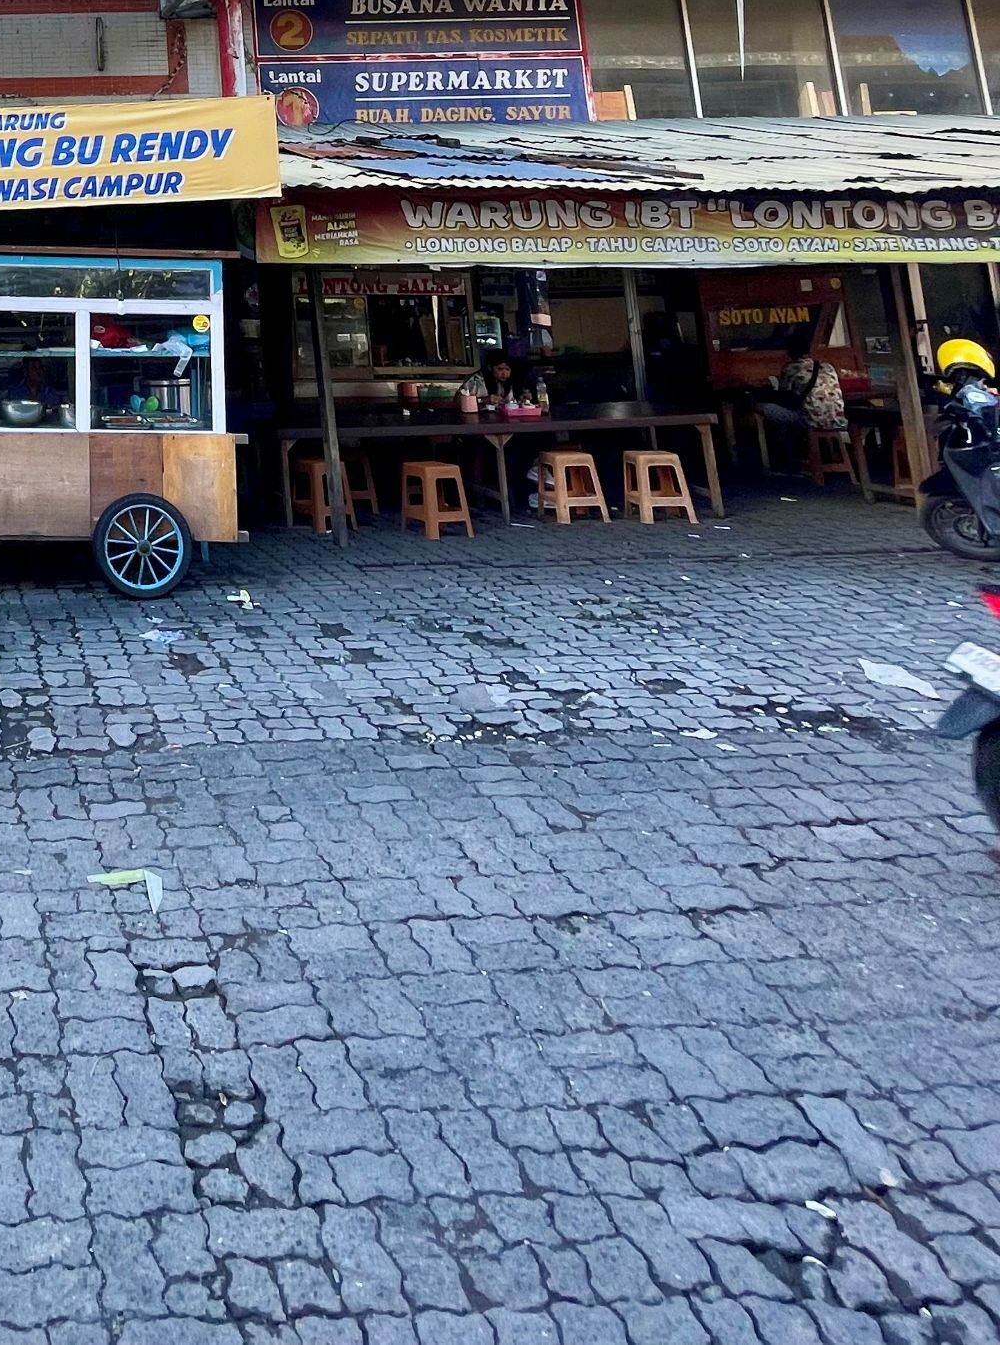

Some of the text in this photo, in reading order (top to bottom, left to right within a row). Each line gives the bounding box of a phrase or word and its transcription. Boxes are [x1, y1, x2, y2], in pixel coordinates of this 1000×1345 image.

[277, 13, 305, 46] 2
[469, 27, 569, 43] KOSMETIK
[269, 69, 322, 83] Lantai
[354, 68, 569, 92] SUPERMARKET
[505, 105, 571, 121] SAYUR
[52, 134, 105, 167] BU
[110, 128, 234, 164] RENDY
[62, 171, 184, 200] CAMPUR
[400, 199, 615, 230] WARUNG
[963, 199, 1000, 231] B
[415, 237, 506, 253] LONTONG
[510, 237, 574, 253] BALAP
[585, 236, 637, 252] TAHU
[640, 236, 720, 253] CAMPUR
[732, 236, 783, 252] SOTO
[787, 236, 840, 252] AYAM
[854, 237, 899, 252] SATE
[901, 237, 979, 251] KERANG
[298, 277, 388, 294] LNTONG
[719, 306, 811, 326] SOTO AYAM
